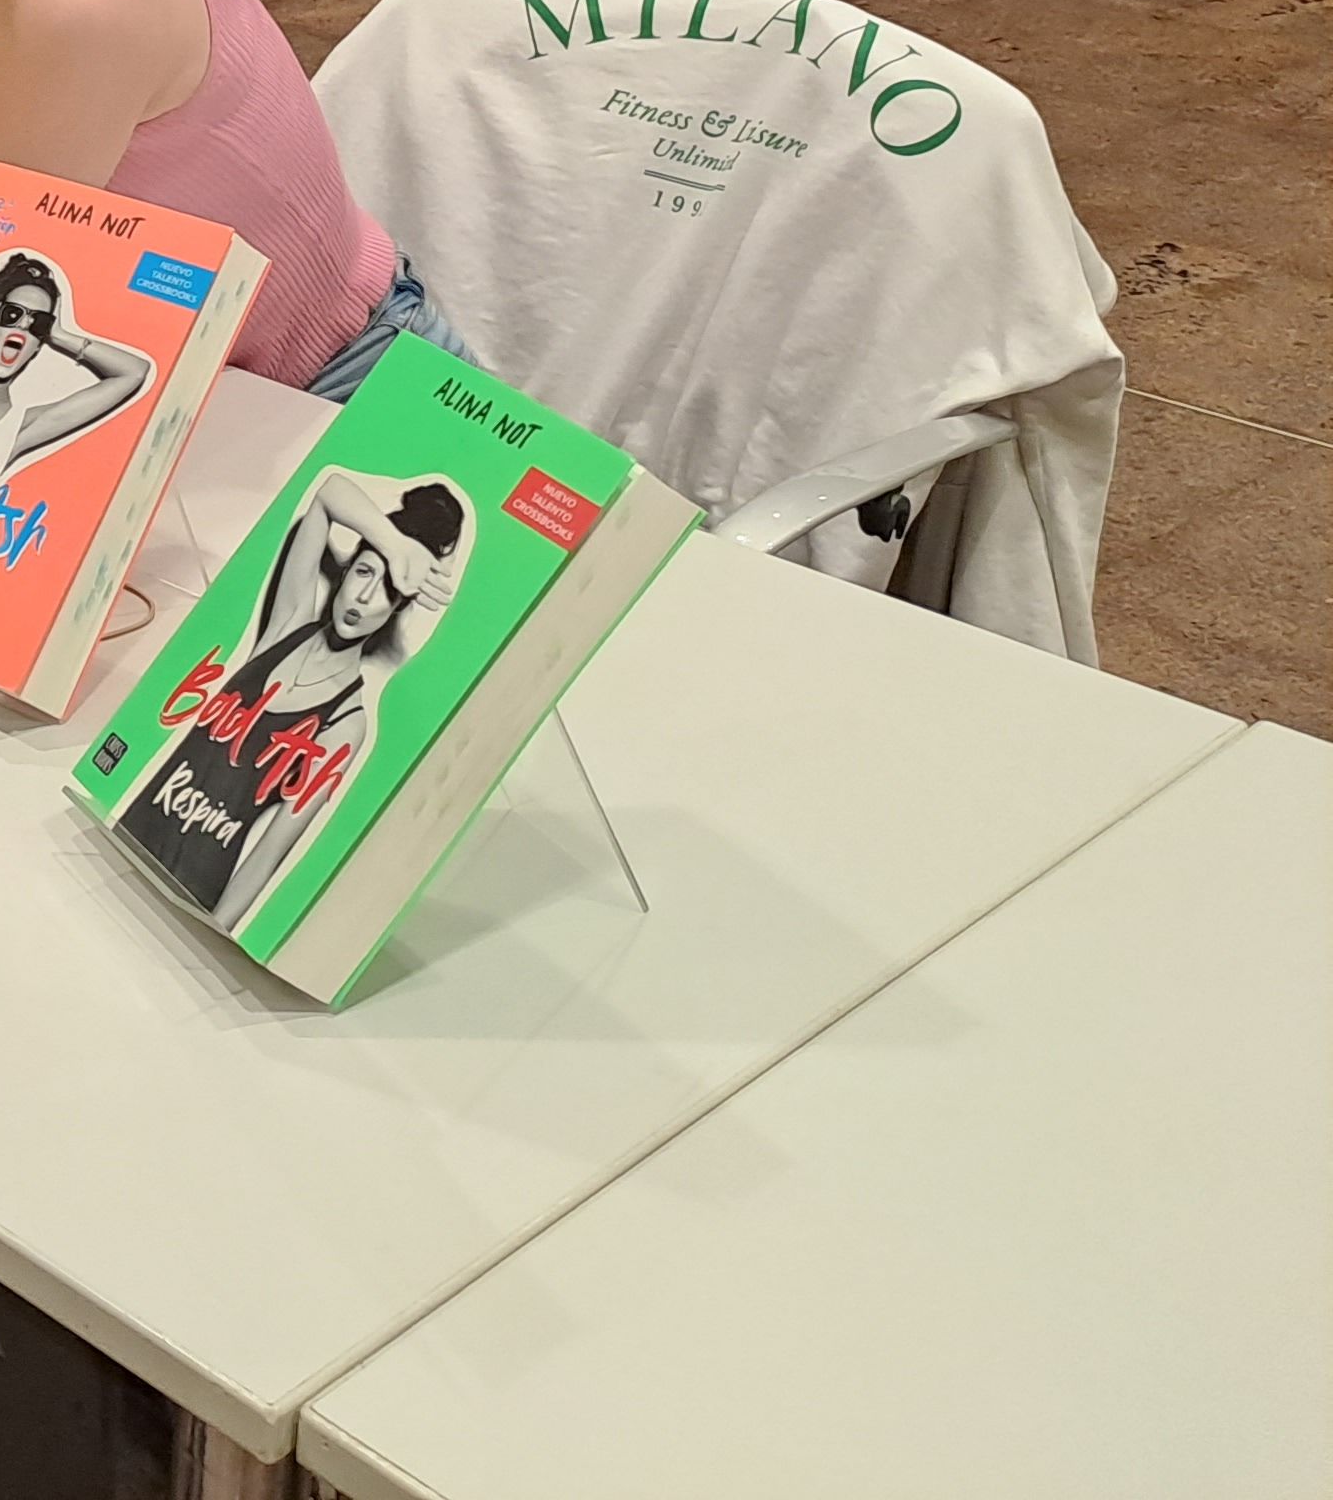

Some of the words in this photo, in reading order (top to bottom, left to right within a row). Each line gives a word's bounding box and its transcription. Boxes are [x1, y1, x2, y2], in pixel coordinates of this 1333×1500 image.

[600, 89, 693, 130] Fitness
[701, 110, 736, 138] &
[35, 192, 93, 226] ALINA
[99, 213, 146, 239] NOT
[152, 270, 192, 289] TALENTO
[160, 261, 193, 277] NUEVO
[433, 377, 493, 425] ALINA
[491, 413, 543, 449] NOT
[531, 492, 573, 523] TALENTO
[543, 483, 577, 509] NUEVO
[512, 498, 574, 541] CROSSBOOKS
[160, 645, 282, 767] Bad
[254, 714, 351, 815] Ash
[152, 760, 243, 849] Respira
